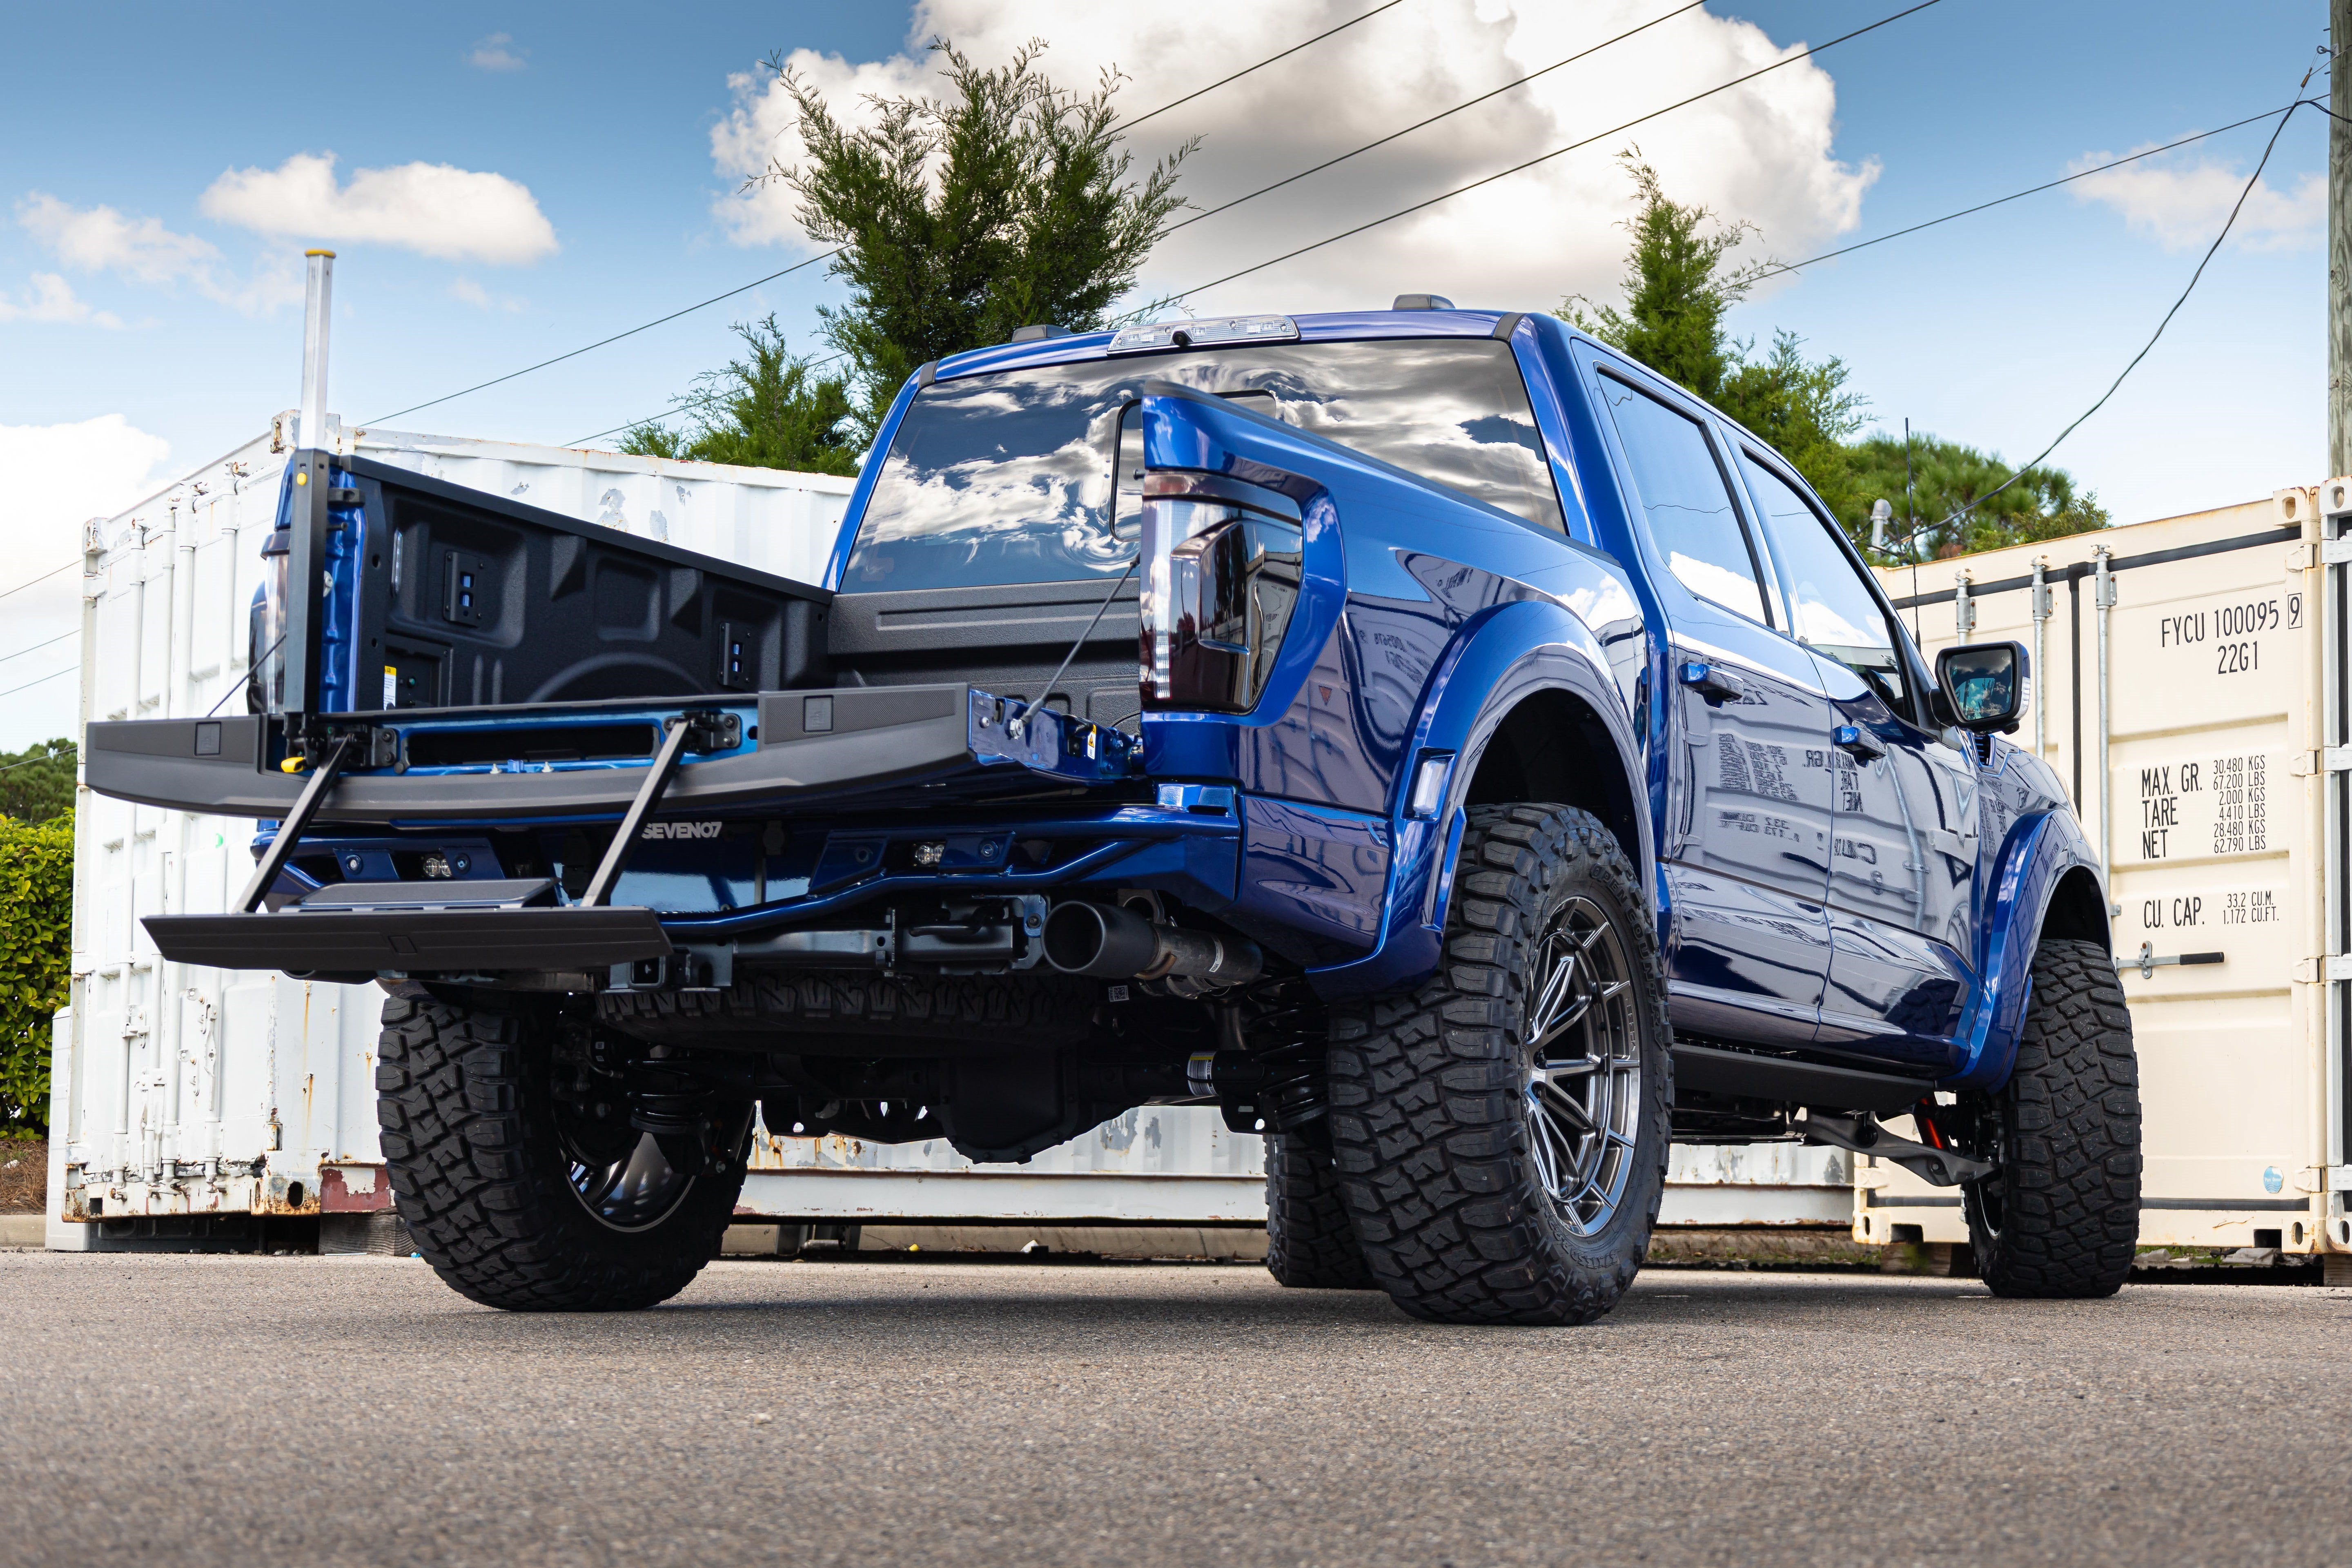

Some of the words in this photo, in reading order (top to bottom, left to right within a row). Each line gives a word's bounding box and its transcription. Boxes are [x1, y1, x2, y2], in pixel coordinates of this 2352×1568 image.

[2162, 612, 2205, 648] FYCU
[2214, 600, 2279, 638] 100095
[2290, 596, 2300, 626] 9
[2218, 641, 2257, 675] 22G1
[2214, 757, 2243, 775] 30,480
[2248, 755, 2265, 772] KGS
[2142, 766, 2173, 797] MAX.
[2181, 763, 2202, 793] GR.
[2213, 775, 2243, 791] 67,200
[2248, 771, 2265, 786] LBS
[2219, 790, 2243, 806] 2,000
[2248, 787, 2265, 803] KGS
[2142, 795, 2178, 828] TARE
[2219, 805, 2243, 821] 4,410
[2248, 803, 2265, 818] LBS
[2214, 821, 2243, 838] 28,480
[2249, 819, 2265, 835] KGS
[2143, 829, 2168, 860] NET
[2214, 837, 2243, 853] 62,790
[2249, 835, 2266, 851] LBS
[1591, 862, 1628, 906] OPEN
[2227, 893, 2246, 908] 33.2
[2252, 891, 2274, 906] CU.M.
[2144, 900, 2164, 929] CU.
[2174, 897, 2205, 927] CAP.
[2223, 909, 2246, 924] 1,172
[2252, 906, 2279, 922] CU.FT.
